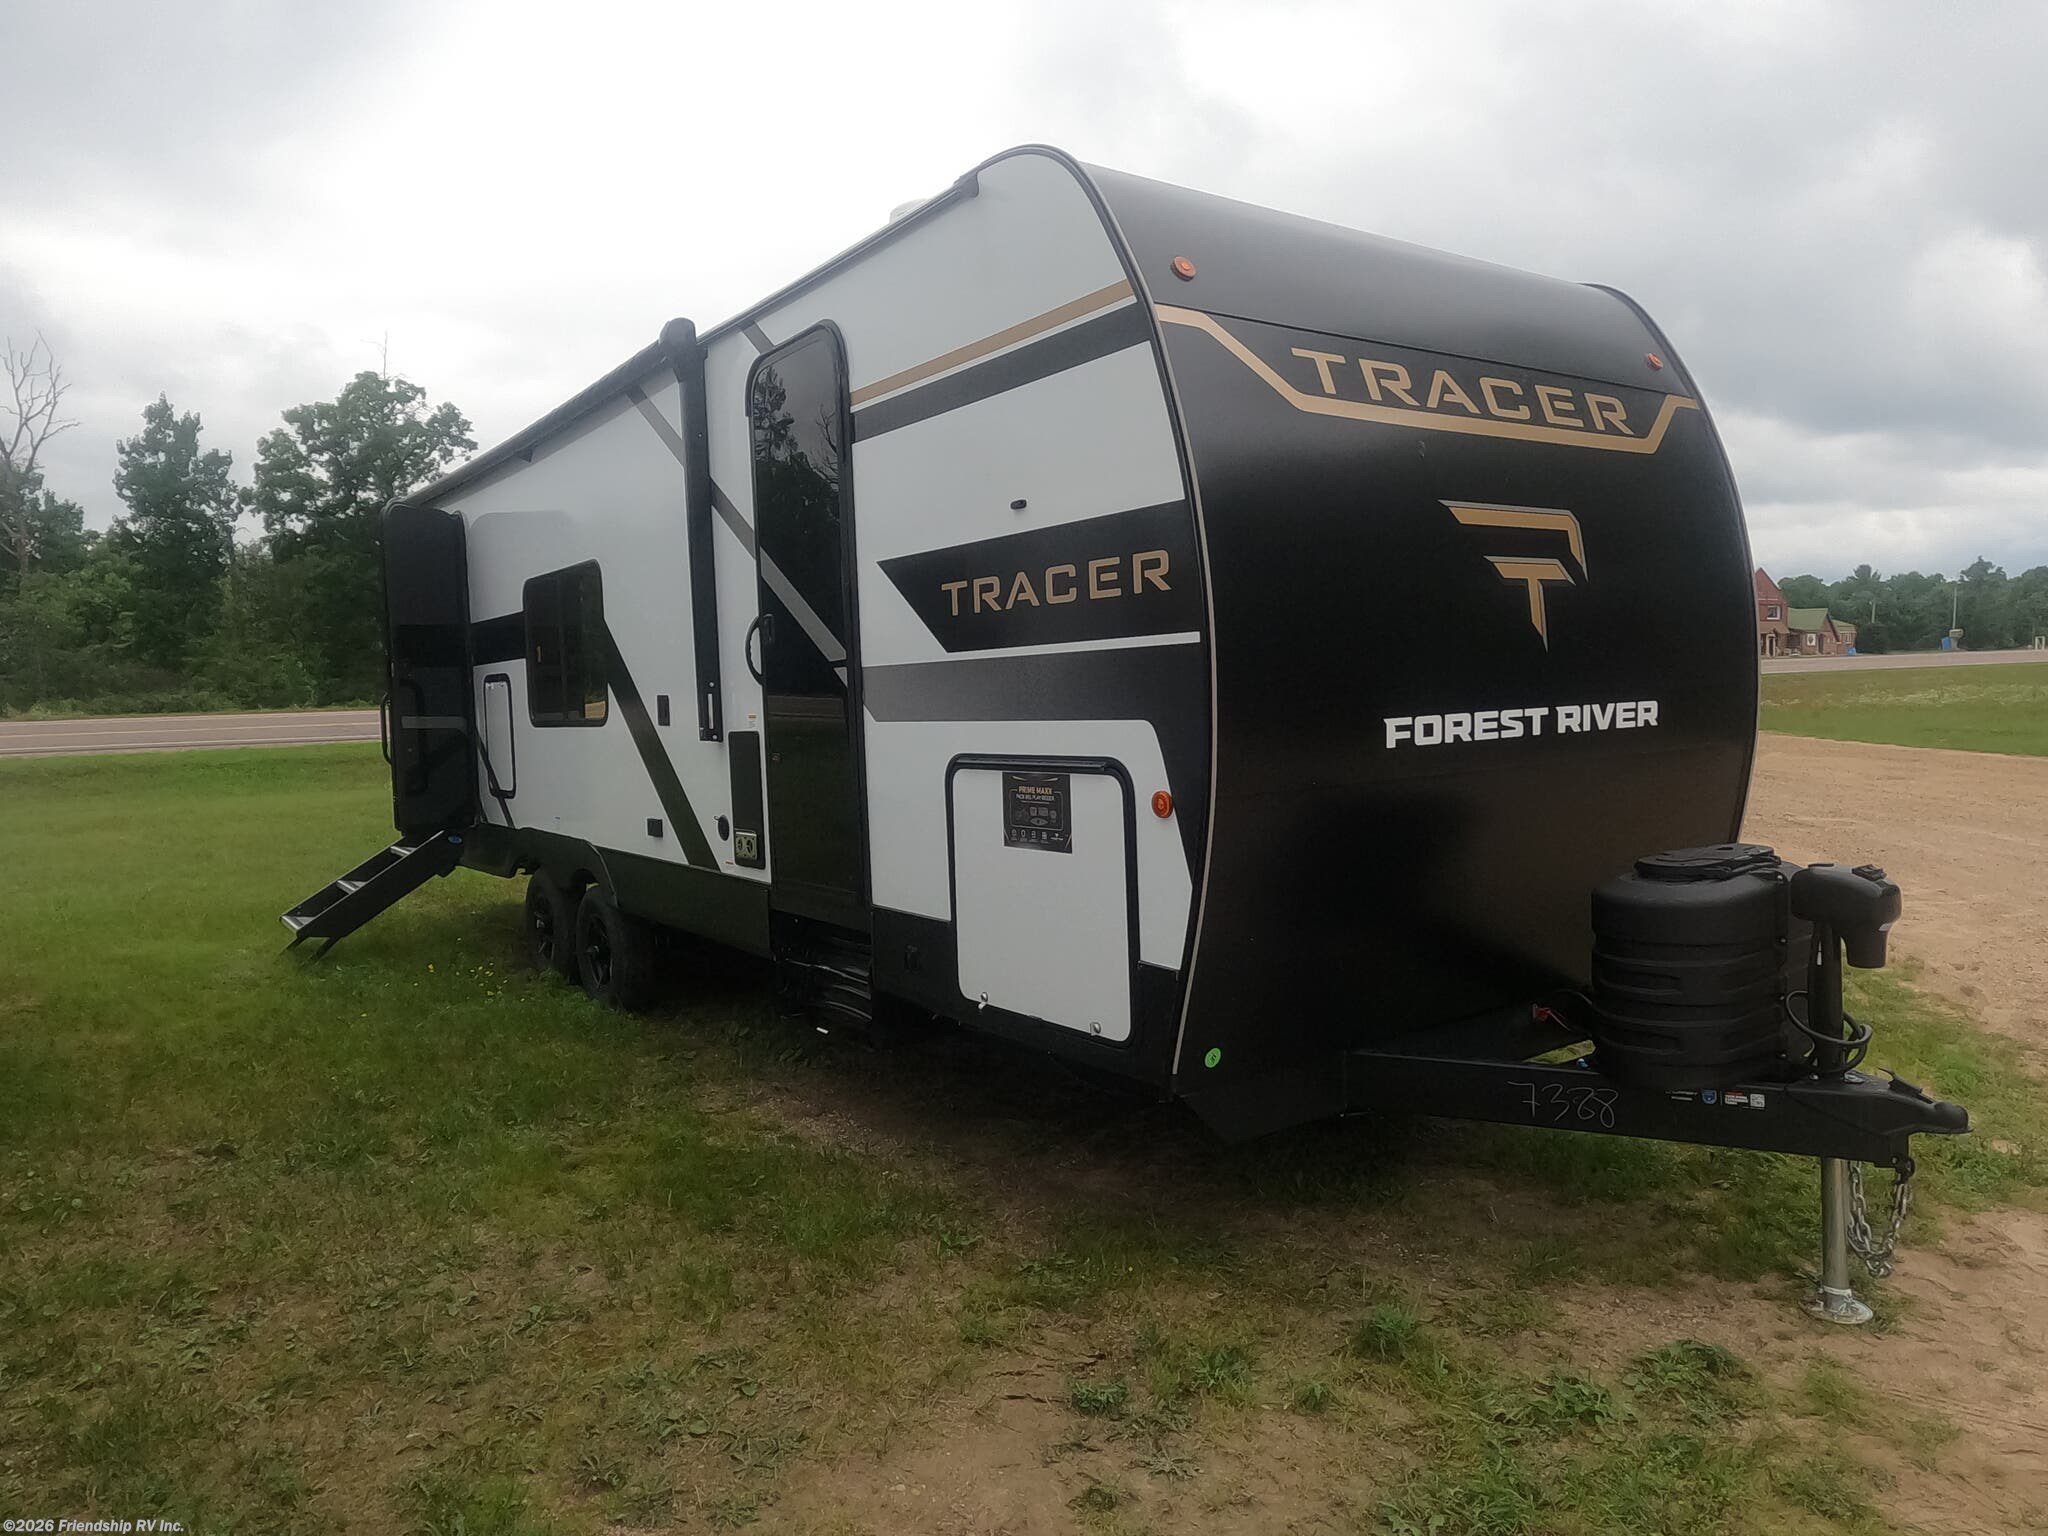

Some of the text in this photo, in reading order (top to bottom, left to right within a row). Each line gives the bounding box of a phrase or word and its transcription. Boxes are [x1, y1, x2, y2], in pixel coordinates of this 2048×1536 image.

[1291, 347, 1634, 435] TRACER
[941, 550, 1171, 616] TRACER
[1383, 700, 1658, 749] FOREST RIVER
